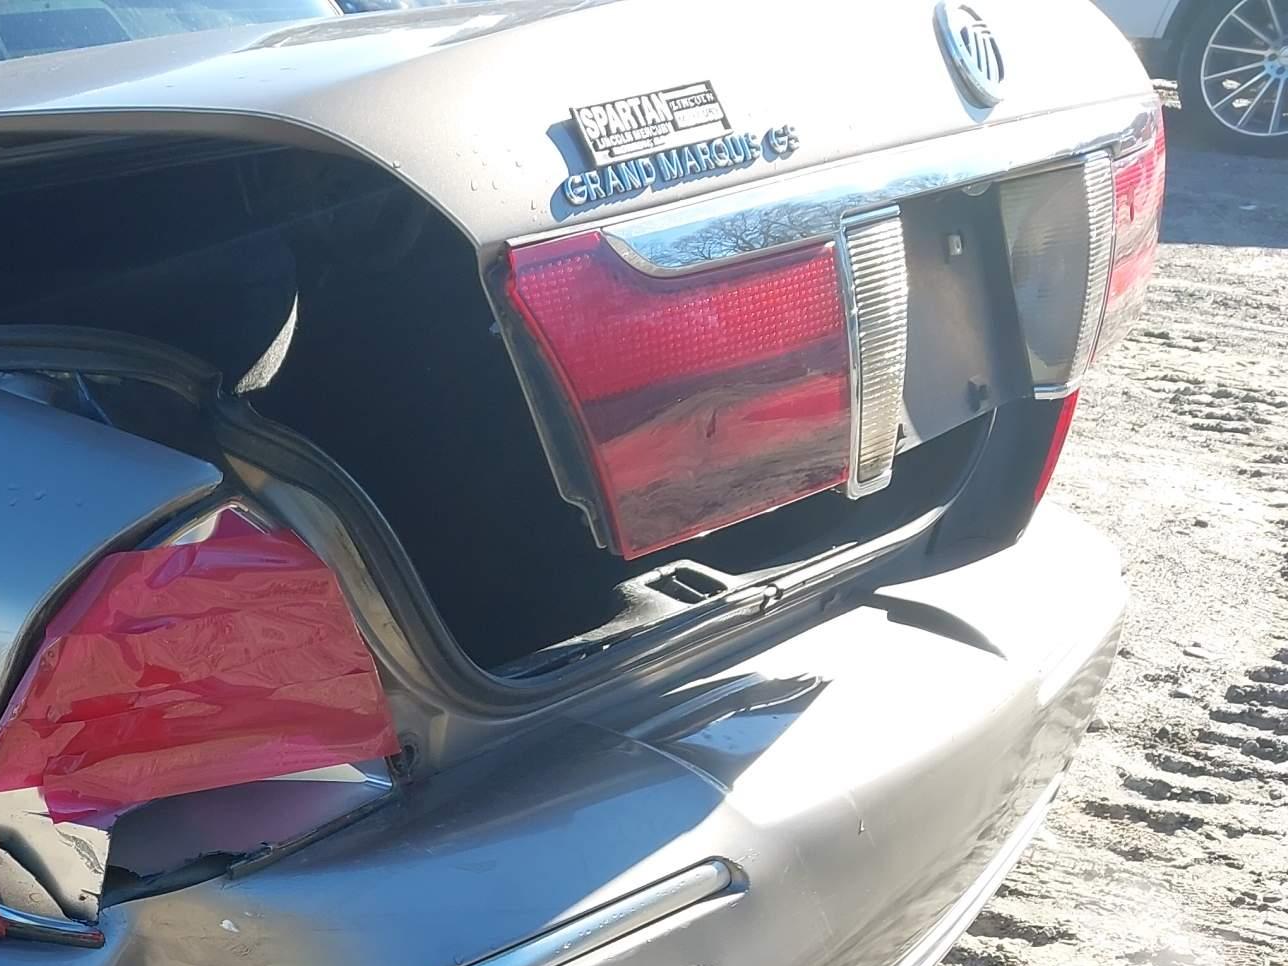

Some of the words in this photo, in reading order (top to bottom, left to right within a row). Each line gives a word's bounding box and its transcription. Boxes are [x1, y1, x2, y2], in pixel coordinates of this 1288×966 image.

[579, 91, 674, 140] SPARTAN
[595, 131, 634, 149] LINCOLN
[565, 156, 657, 206] GRAND
[660, 131, 764, 181] MARQUIS
